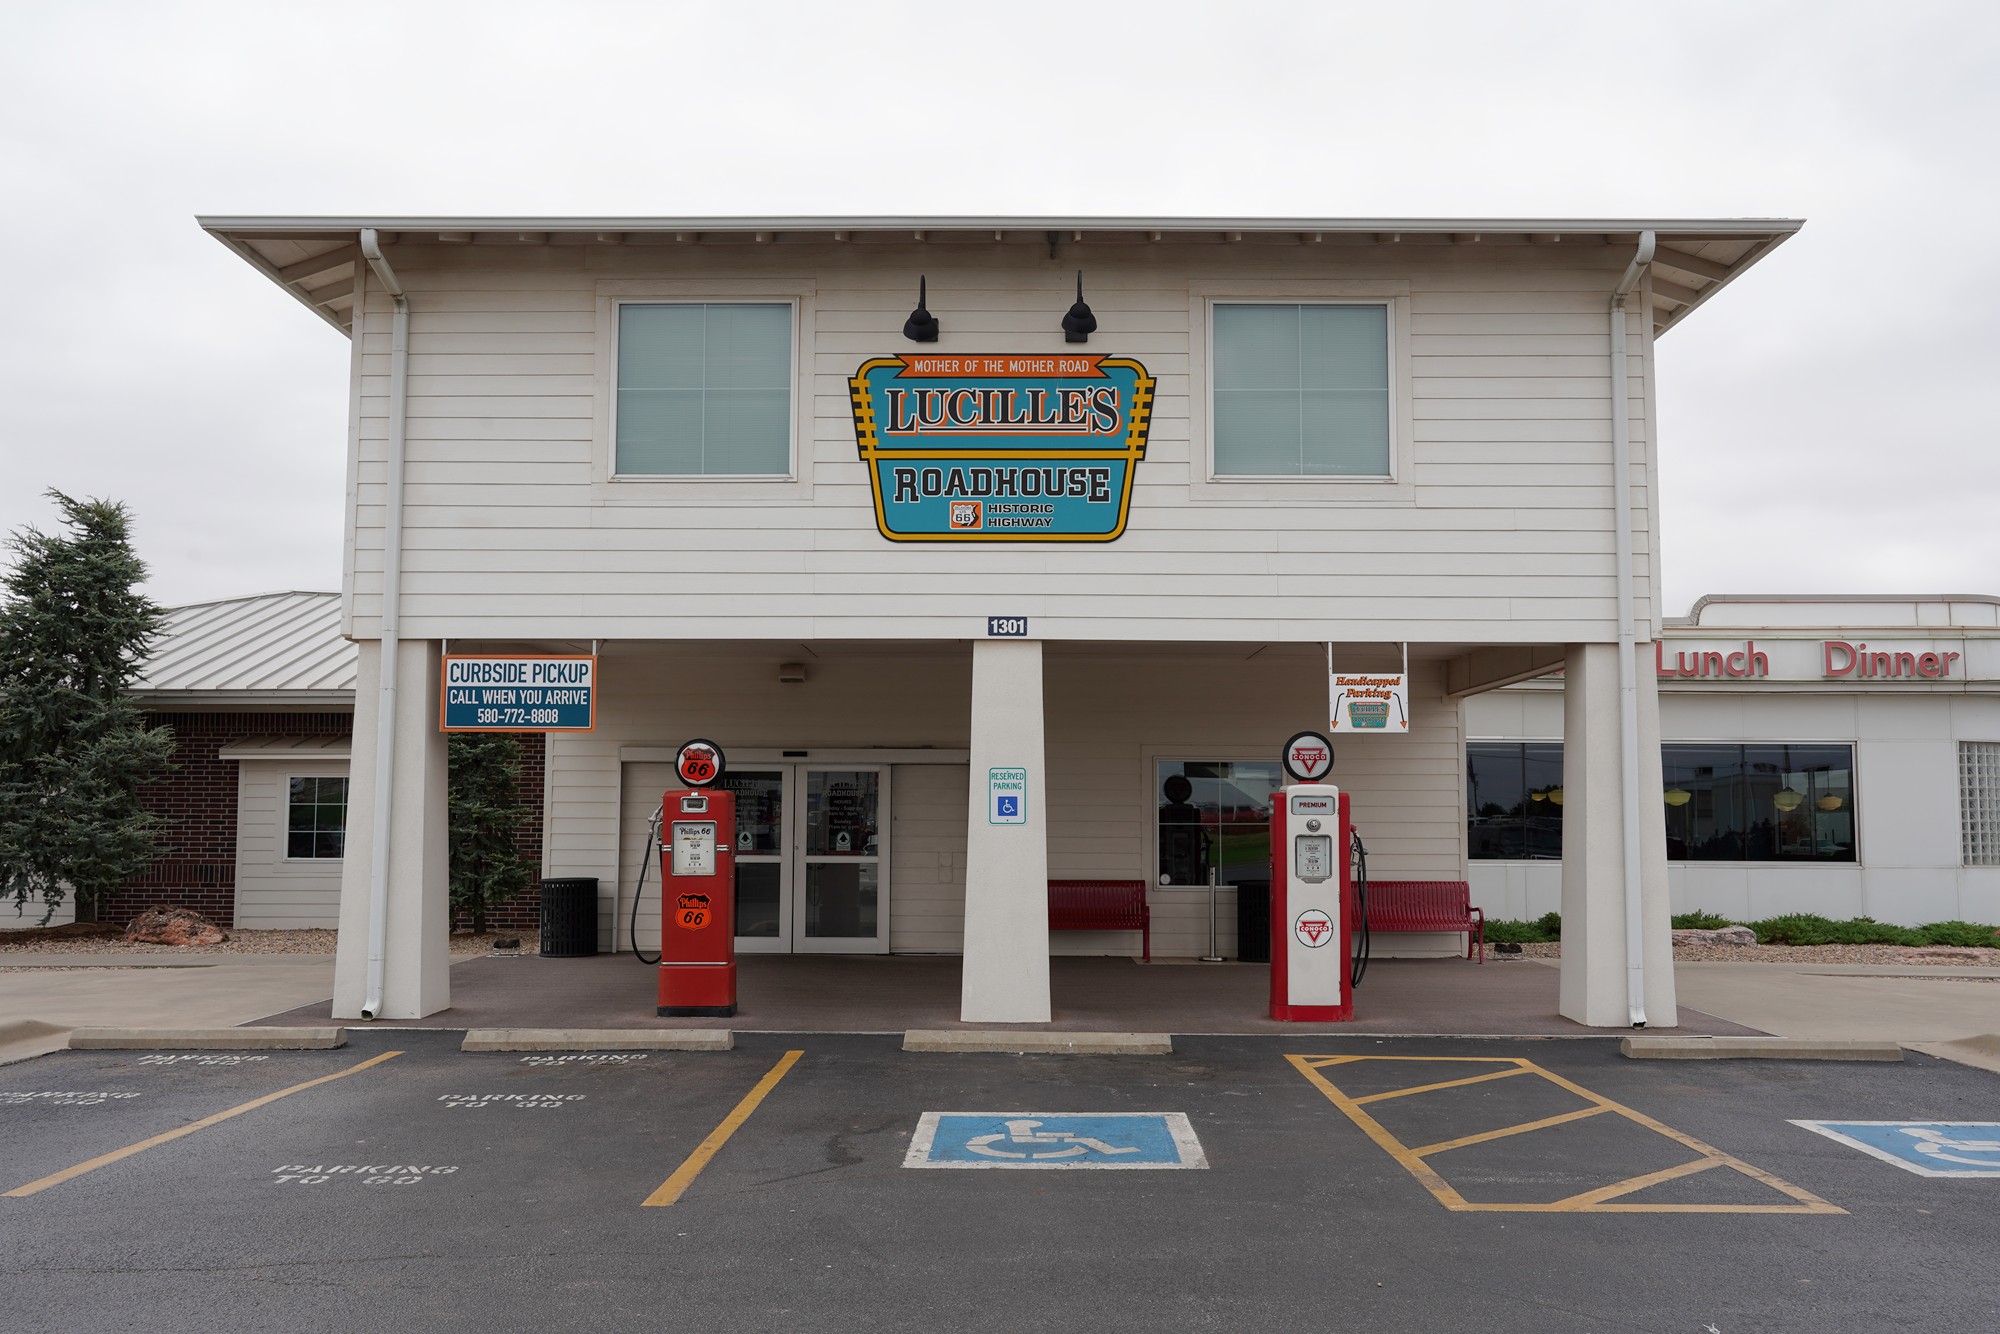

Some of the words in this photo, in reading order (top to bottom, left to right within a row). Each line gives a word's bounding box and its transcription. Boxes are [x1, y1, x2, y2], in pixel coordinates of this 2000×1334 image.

[914, 360, 959, 372] MOTHER
[964, 360, 979, 372] OF
[983, 360, 1004, 372] THE
[1010, 360, 1054, 372] MOTHER
[1059, 360, 1089, 372] ROAD
[885, 387, 1121, 434] LUCILLE'S
[893, 467, 1111, 503] ROADHOUSE
[988, 503, 1054, 514] HISTORIC
[956, 514, 971, 522] 66
[988, 517, 1053, 528] HIGHWAY
[990, 619, 1025, 634] 1301
[1656, 641, 1768, 677] Lunch
[1823, 641, 1960, 677] Dinner
[450, 663, 527, 683] CURBSIDE
[532, 664, 588, 684] PICKUP
[1336, 676, 1401, 688] Handicapped
[450, 690, 478, 704] CALL
[482, 690, 516, 704] WHEN
[519, 690, 542, 704] YOU
[546, 690, 588, 704] ARRIVE
[1346, 688, 1392, 700] Parking
[477, 708, 558, 724] 580-772-8808
[684, 750, 711, 760] Phillips
[688, 762, 709, 776] 66
[680, 827, 700, 836] Phillips
[680, 897, 706, 910] Phillips
[684, 911, 704, 925] 66
[271, 1165, 459, 1174] PARKING
[274, 1175, 330, 1184] TO
[362, 1176, 423, 1184] GO
